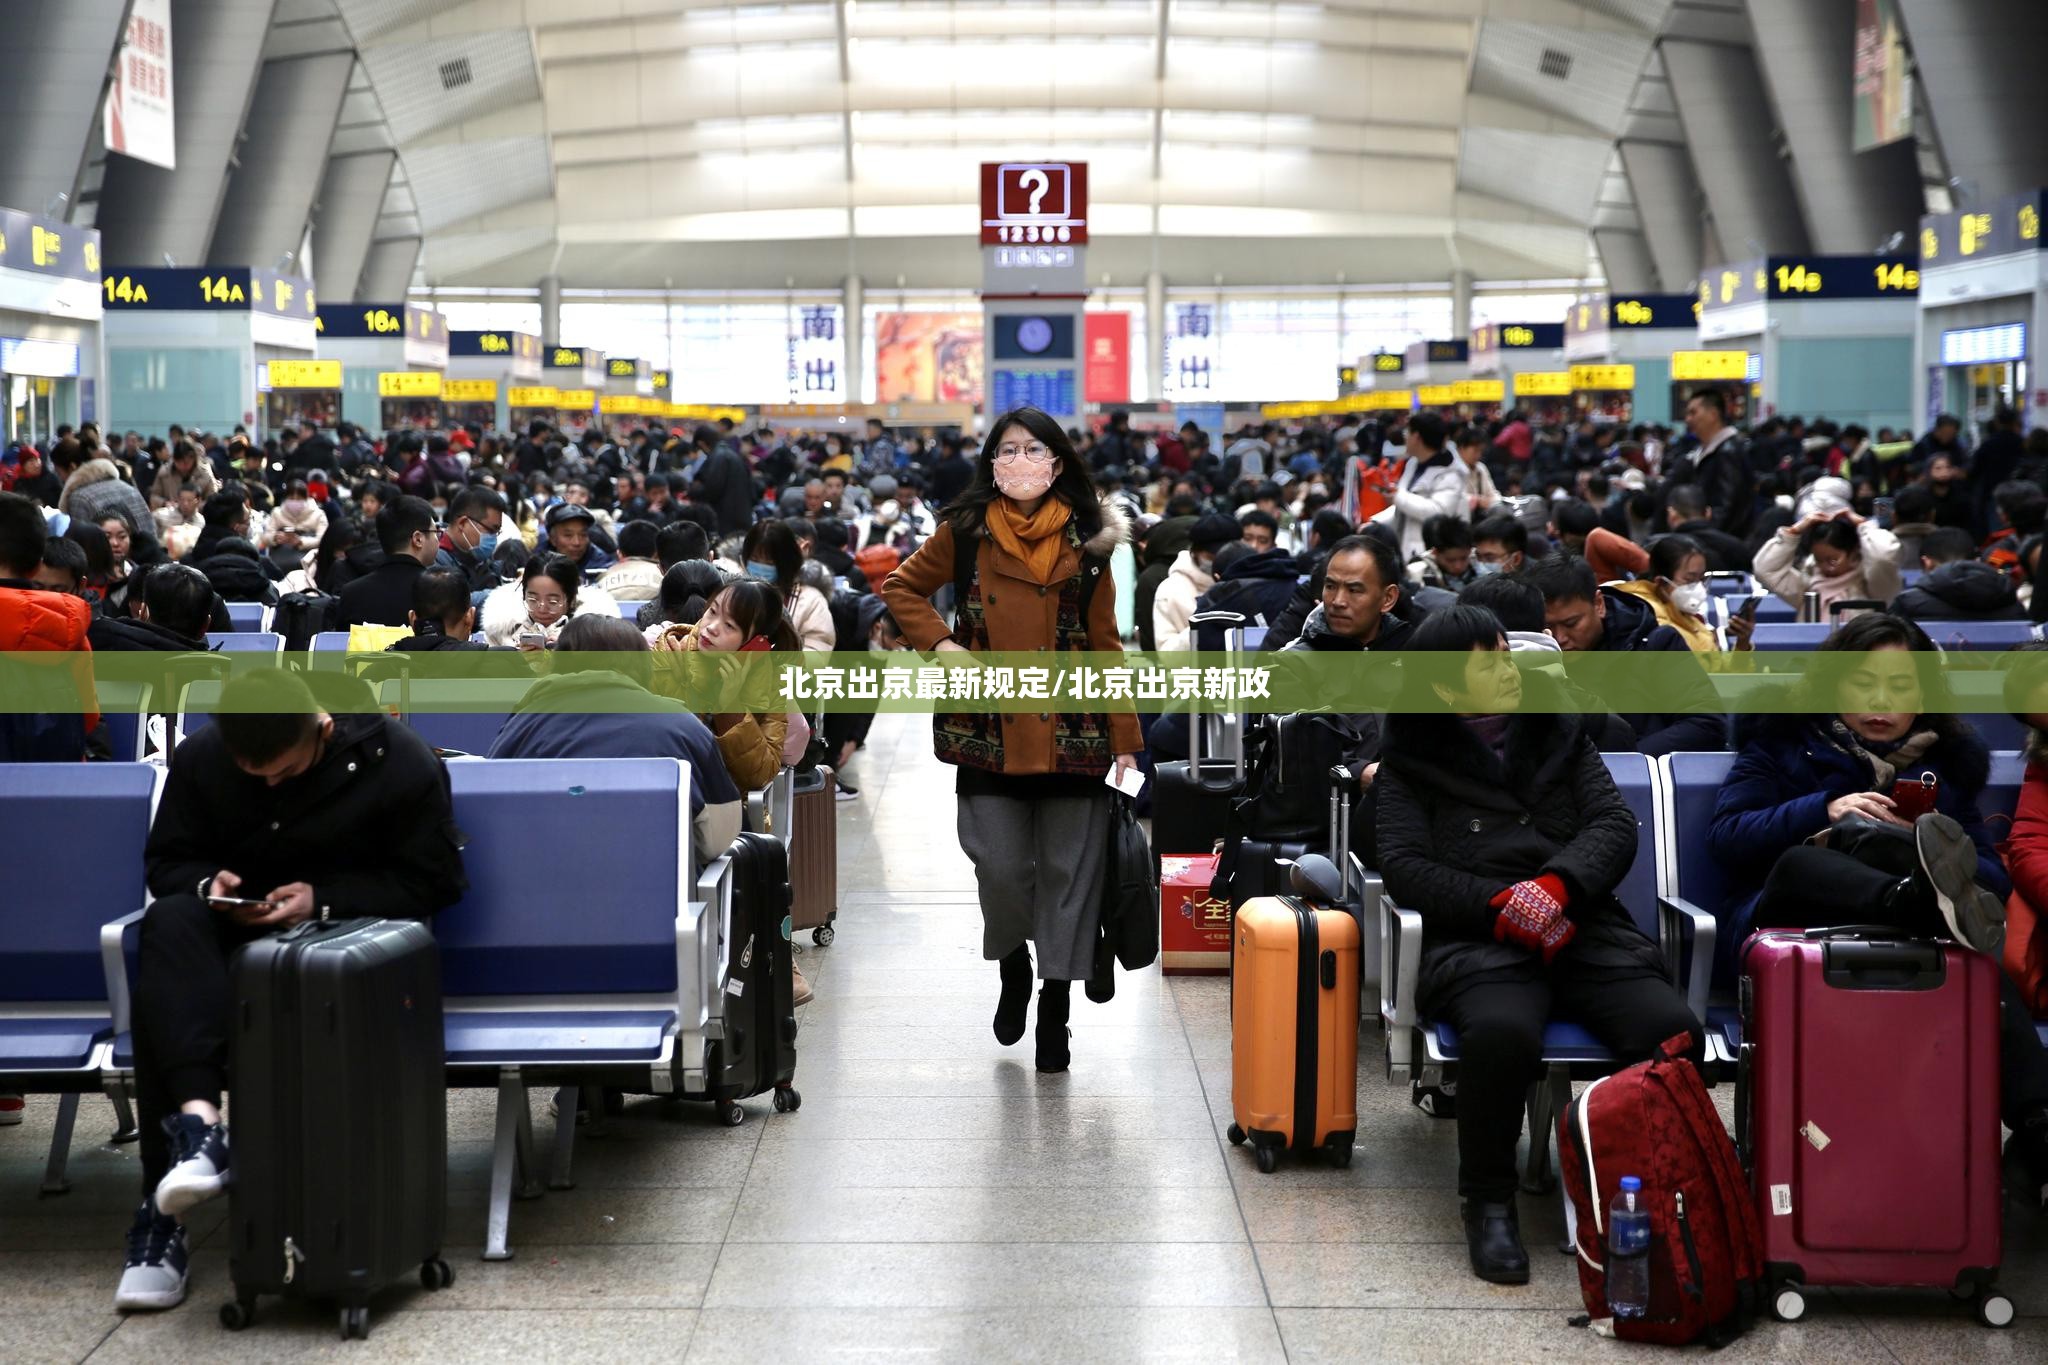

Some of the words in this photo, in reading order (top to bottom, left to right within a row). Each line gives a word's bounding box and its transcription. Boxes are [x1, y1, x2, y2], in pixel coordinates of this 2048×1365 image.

[997, 225, 1071, 243] 12306
[103, 276, 149, 303] 14A
[199, 276, 245, 303] 14A
[363, 309, 401, 333] 16A
